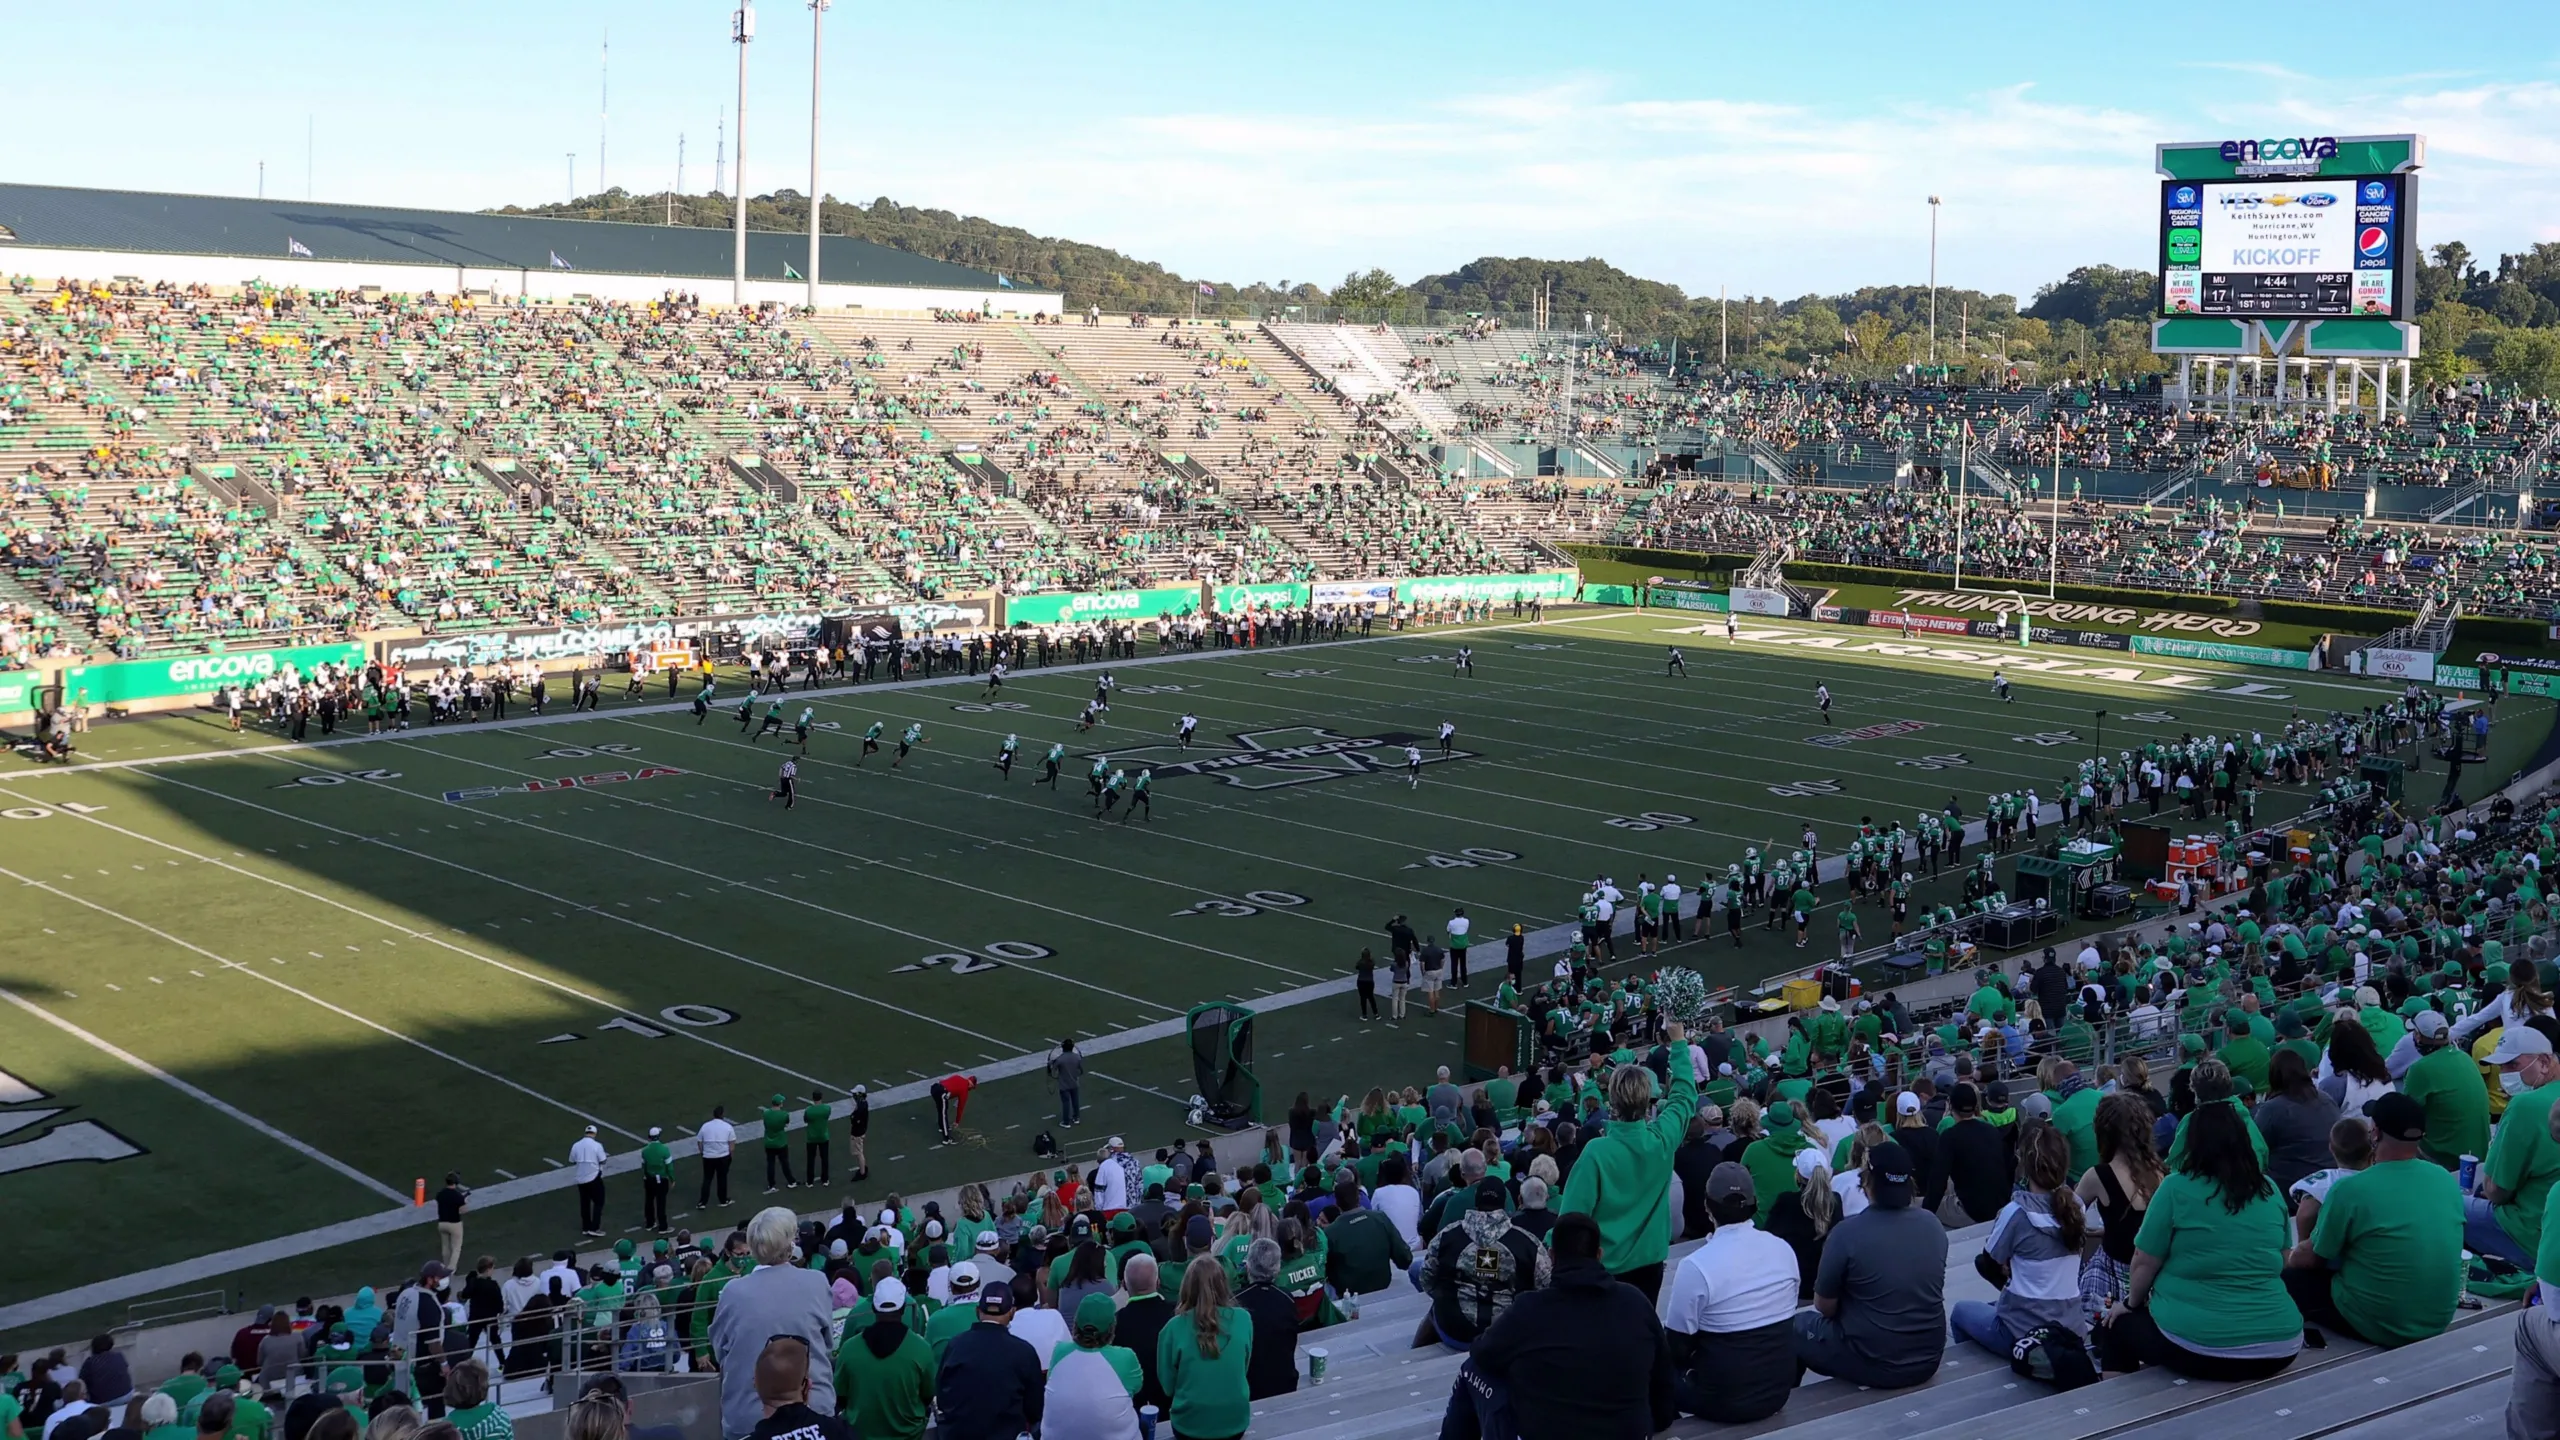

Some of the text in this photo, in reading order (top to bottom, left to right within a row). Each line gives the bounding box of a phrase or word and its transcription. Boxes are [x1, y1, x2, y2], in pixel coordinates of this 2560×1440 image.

[2220, 137, 2337, 162] encova
[2236, 165, 2318, 174] INSURANCE
[2219, 192, 2258, 210] YES
[2306, 194, 2331, 206] Ford
[2231, 213, 2323, 221] KeithSaysYes.com
[2233, 248, 2320, 266] KICKOFF
[2360, 258, 2386, 268] pepsi
[2212, 275, 2226, 284] MU
[2263, 276, 2287, 287] 4:44
[2315, 275, 2348, 283] APP ST
[2211, 289, 2227, 302] 17
[2329, 290, 2338, 302] 7
[2358, 287, 2386, 295] GOMART
[2239, 300, 2255, 308] 1ST
[2260, 300, 2270, 309] 10
[2300, 300, 2306, 309] 3
[1072, 592, 1139, 612] encova
[1253, 588, 1292, 606] pepsi
[1676, 598, 1720, 612] MARSHALL
[1820, 607, 1840, 618] WCHS
[1892, 588, 2262, 637] THUNDERING HERD
[1869, 612, 1967, 632] 11 EYEWNESS NEWS
[1976, 621, 1998, 632] HTS
[514, 625, 672, 652] WELCOME TO
[2079, 631, 2102, 643] HTS
[168, 652, 275, 682] encova
[1652, 623, 2295, 700] MARSHALL
[2386, 663, 2400, 671] KIA
[950, 701, 1032, 714] 50
[1158, 737, 1384, 773] THE HERD
[297, 768, 403, 787] 20
[1767, 779, 1841, 798] 40
[1602, 811, 1697, 832] 50
[1867, 841, 1874, 852] 6
[1425, 847, 1520, 871] 40
[1777, 875, 1790, 887] 87
[1194, 890, 1309, 918] 30
[1584, 910, 1598, 922] 43
[920, 941, 1054, 975] 20
[1625, 994, 1642, 1009] 78
[598, 1004, 736, 1038] 10
[1288, 1265, 1317, 1284] TUCKER
[1467, 1371, 1493, 1400] OMMY
